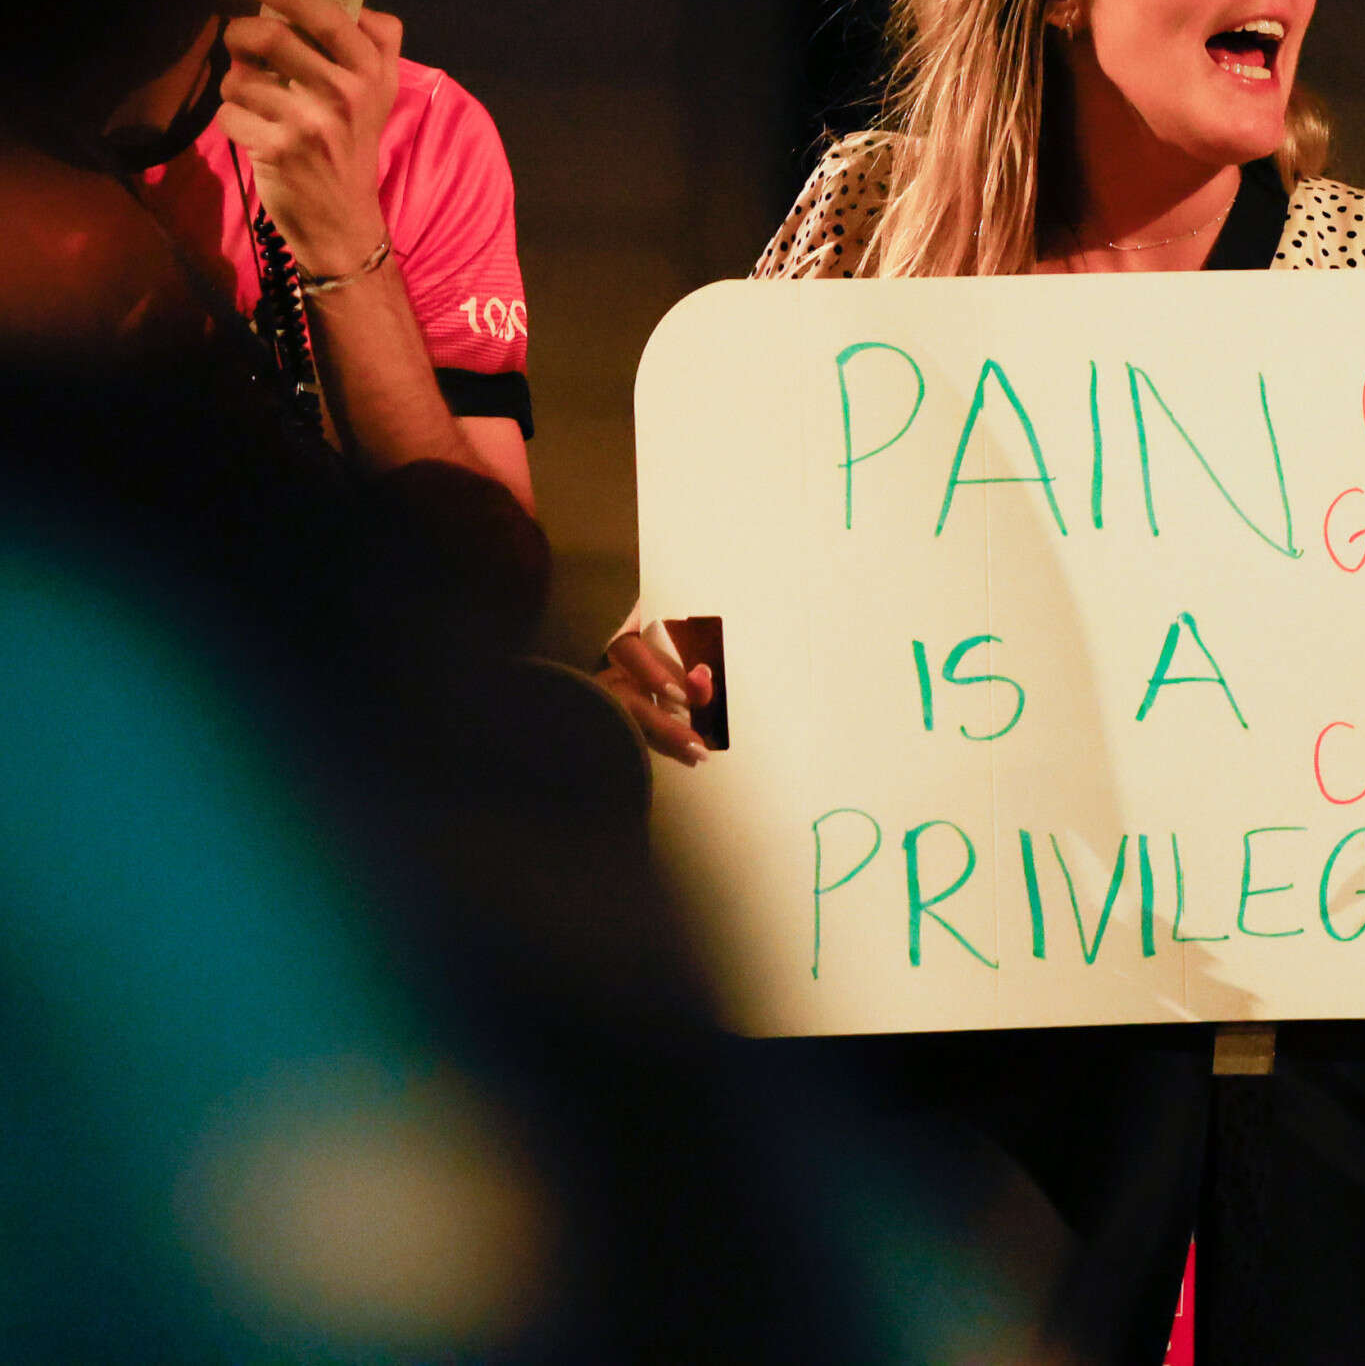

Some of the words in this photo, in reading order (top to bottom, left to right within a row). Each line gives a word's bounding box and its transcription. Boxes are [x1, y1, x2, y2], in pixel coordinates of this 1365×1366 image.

[836, 341, 1303, 559] PAIN
[912, 634, 1026, 741] IS
[1136, 611, 1249, 730] A
